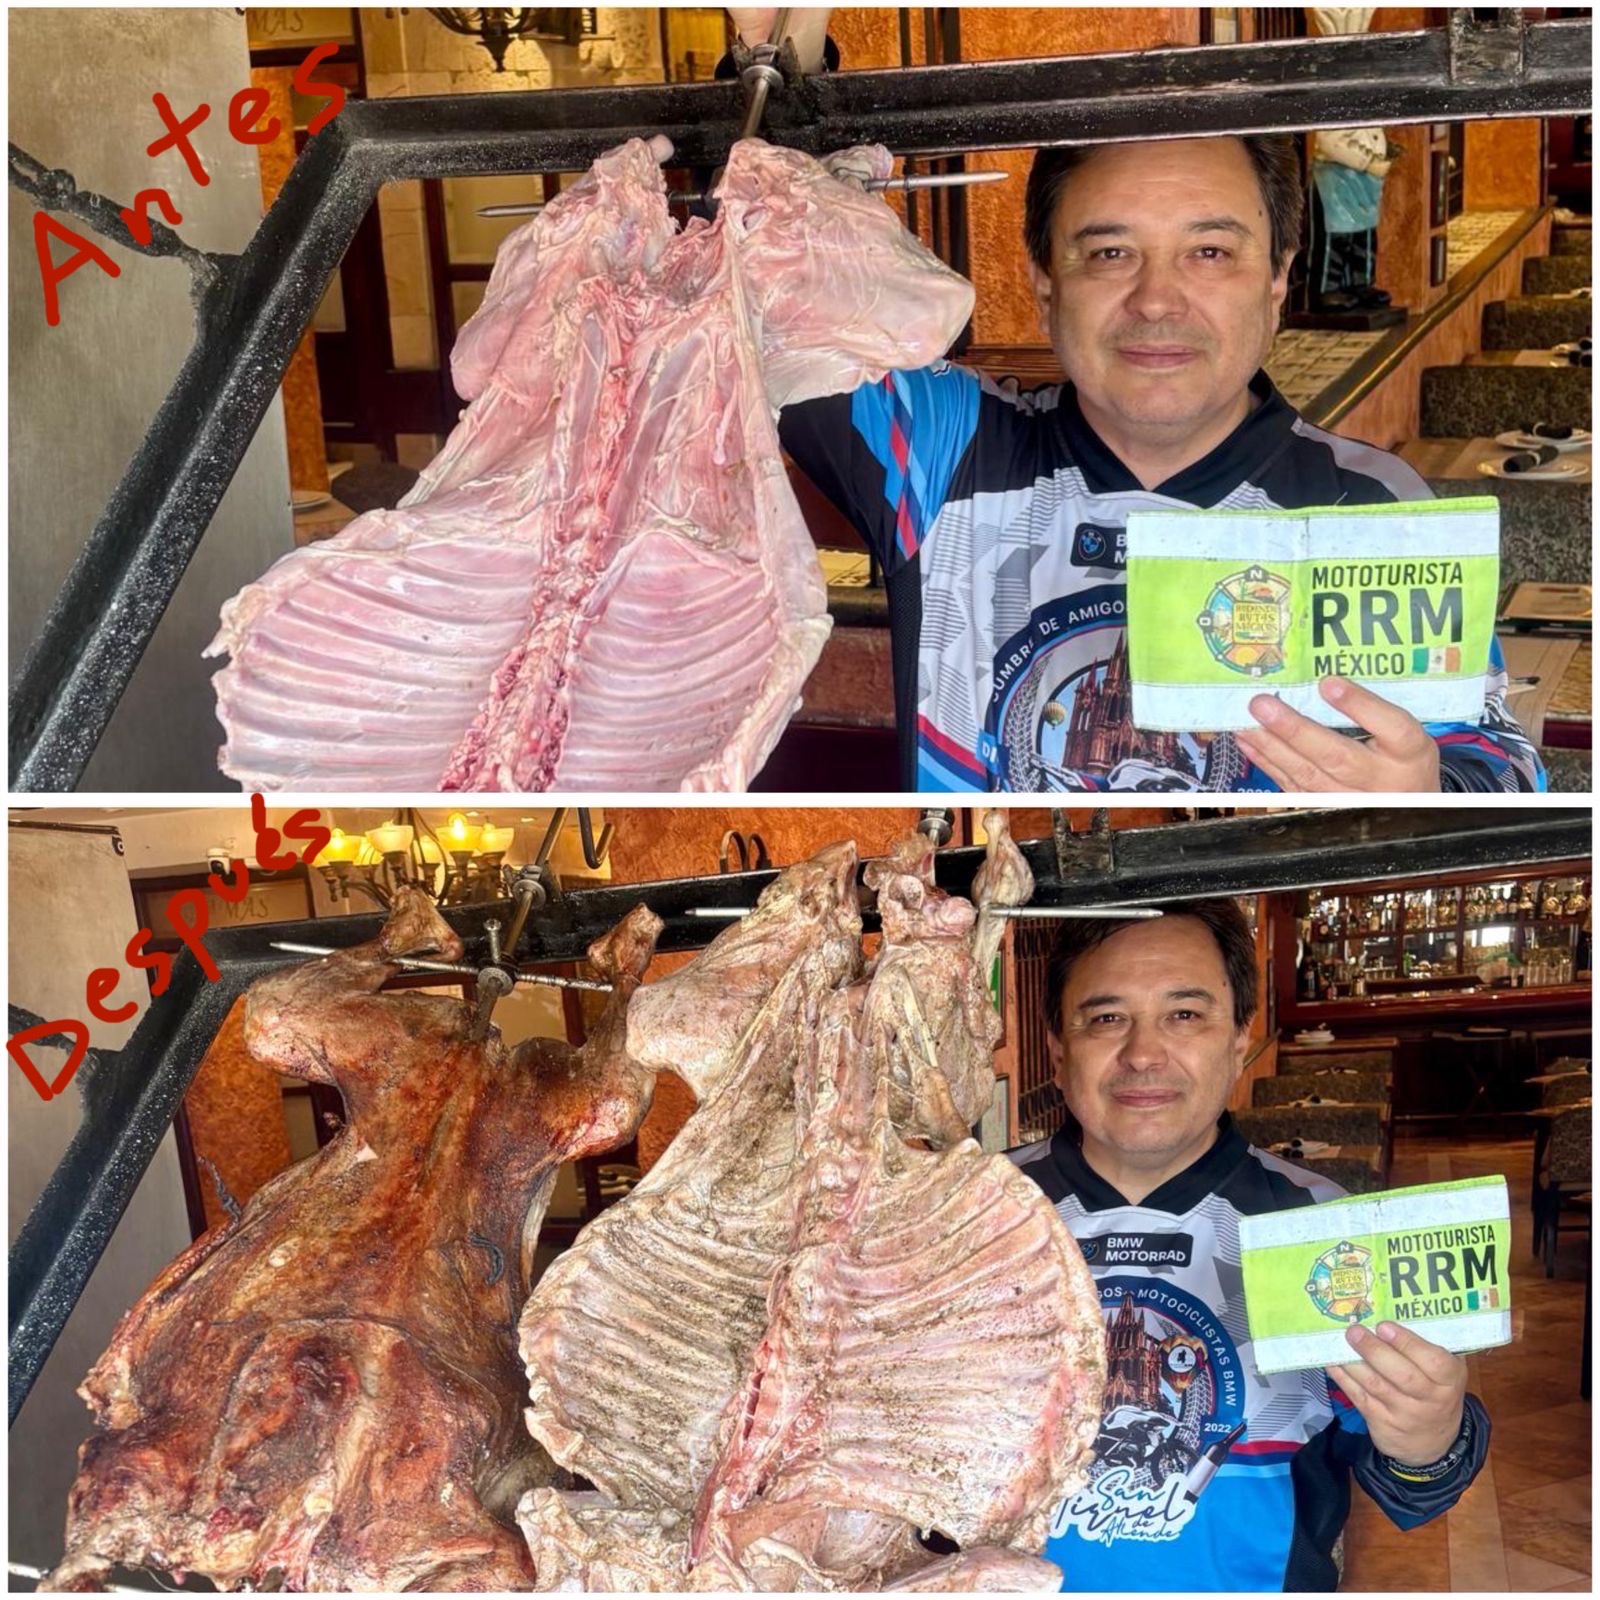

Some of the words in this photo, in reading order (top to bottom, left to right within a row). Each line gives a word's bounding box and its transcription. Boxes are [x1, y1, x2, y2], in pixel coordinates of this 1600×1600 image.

[1312, 562, 1463, 589] MOTOTURISTA
[1038, 617, 1060, 636] DE
[1068, 601, 1126, 625] AMIGO
[1312, 587, 1463, 648] RRM
[1314, 650, 1405, 677] MÉXICO
[1106, 1237, 1144, 1249] BMW
[1387, 1224, 1496, 1256] MOTOTURISTA
[1105, 1250, 1186, 1263] MOTORRAD
[1388, 1244, 1498, 1299] RRM
[1395, 1295, 1463, 1320] MÉXICO
[1137, 1288, 1231, 1366] MOTOCICLISTAS
[1223, 1370, 1237, 1407] BMW
[1204, 1422, 1232, 1434] 2022
[1096, 1469, 1166, 1511] San
[1131, 1515, 1154, 1528] de
